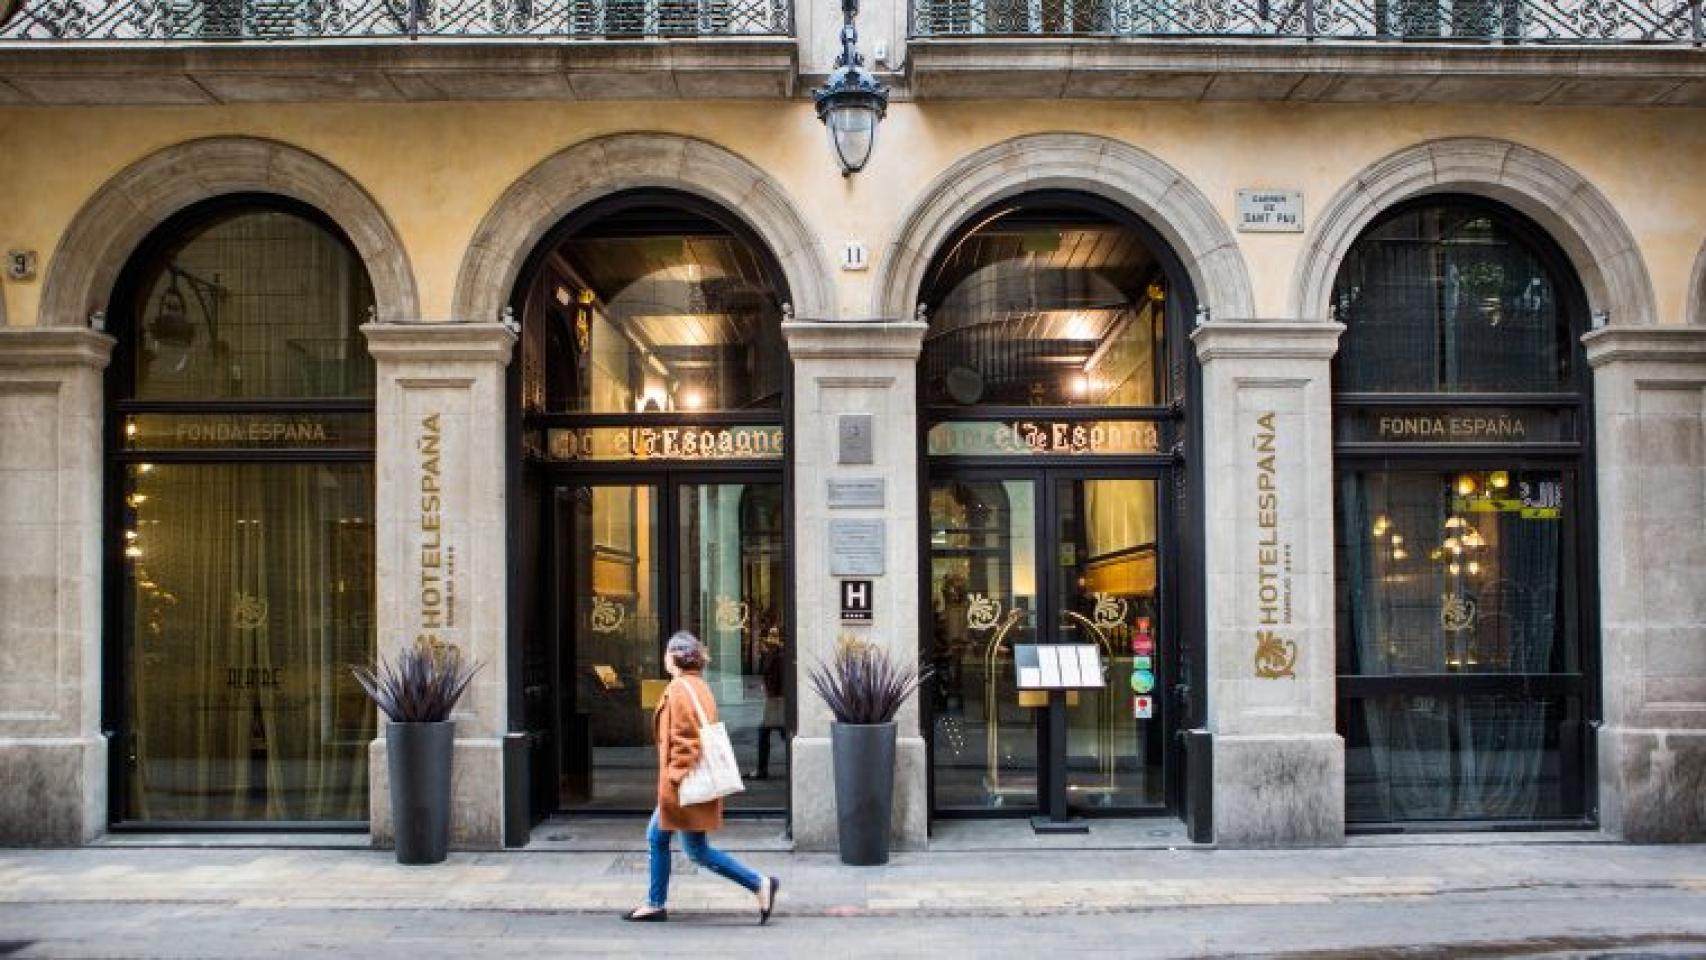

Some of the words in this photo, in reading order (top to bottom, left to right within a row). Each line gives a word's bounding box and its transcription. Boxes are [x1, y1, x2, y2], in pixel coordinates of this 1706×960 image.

[14, 253, 26, 275] 9
[176, 422, 244, 441] FONDA
[249, 418, 326, 441] ESPAÑA
[1379, 416, 1446, 436] FONDA
[1451, 414, 1526, 437] ESPAÑA
[846, 582, 867, 609] H
